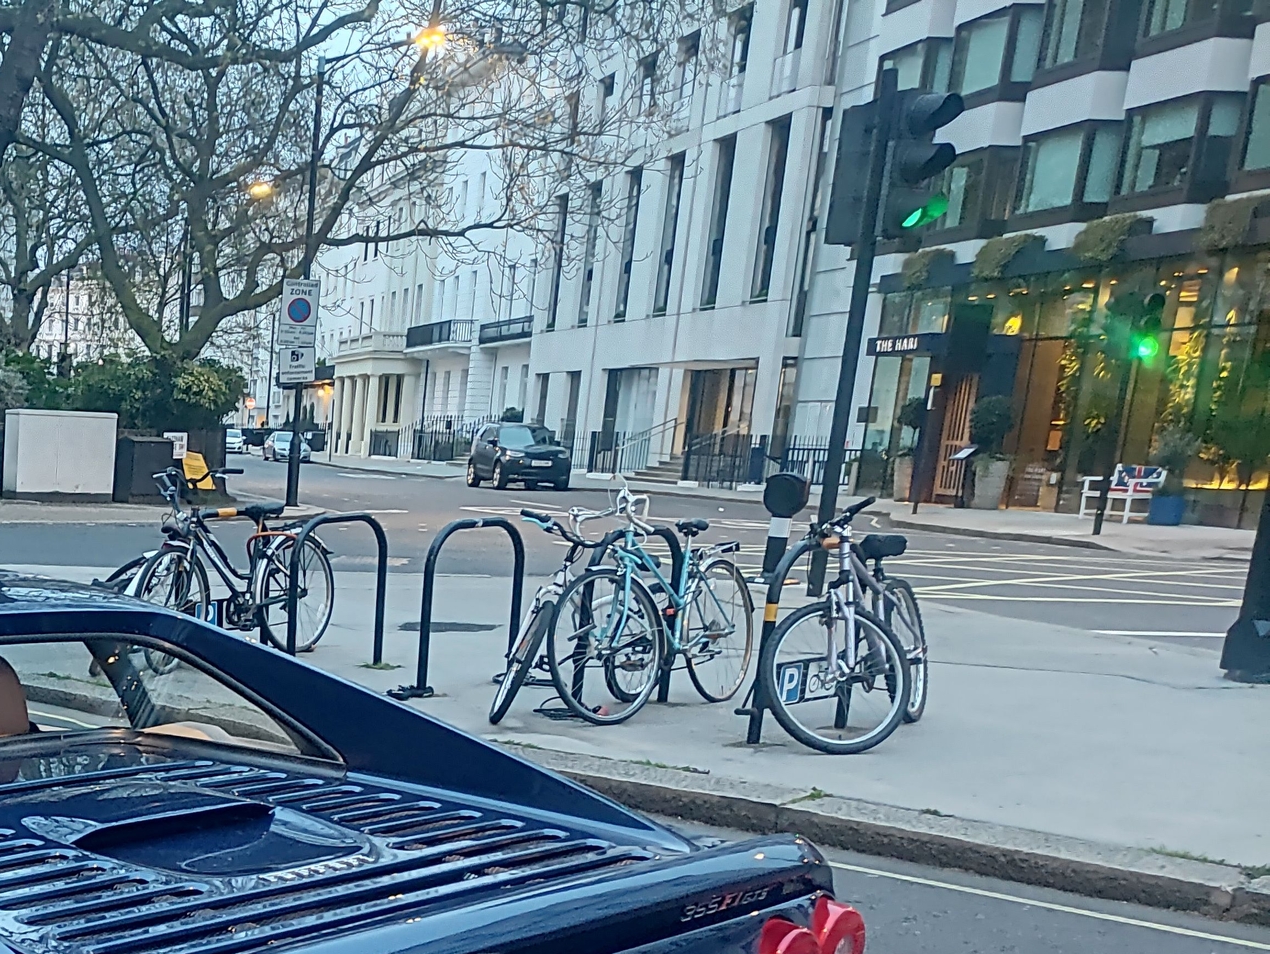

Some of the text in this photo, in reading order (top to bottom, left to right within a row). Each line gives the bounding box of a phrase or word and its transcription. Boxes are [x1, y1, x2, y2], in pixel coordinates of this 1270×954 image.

[290, 288, 313, 296] ZONE
[875, 337, 918, 352] THE HARI
[782, 668, 799, 701] P
